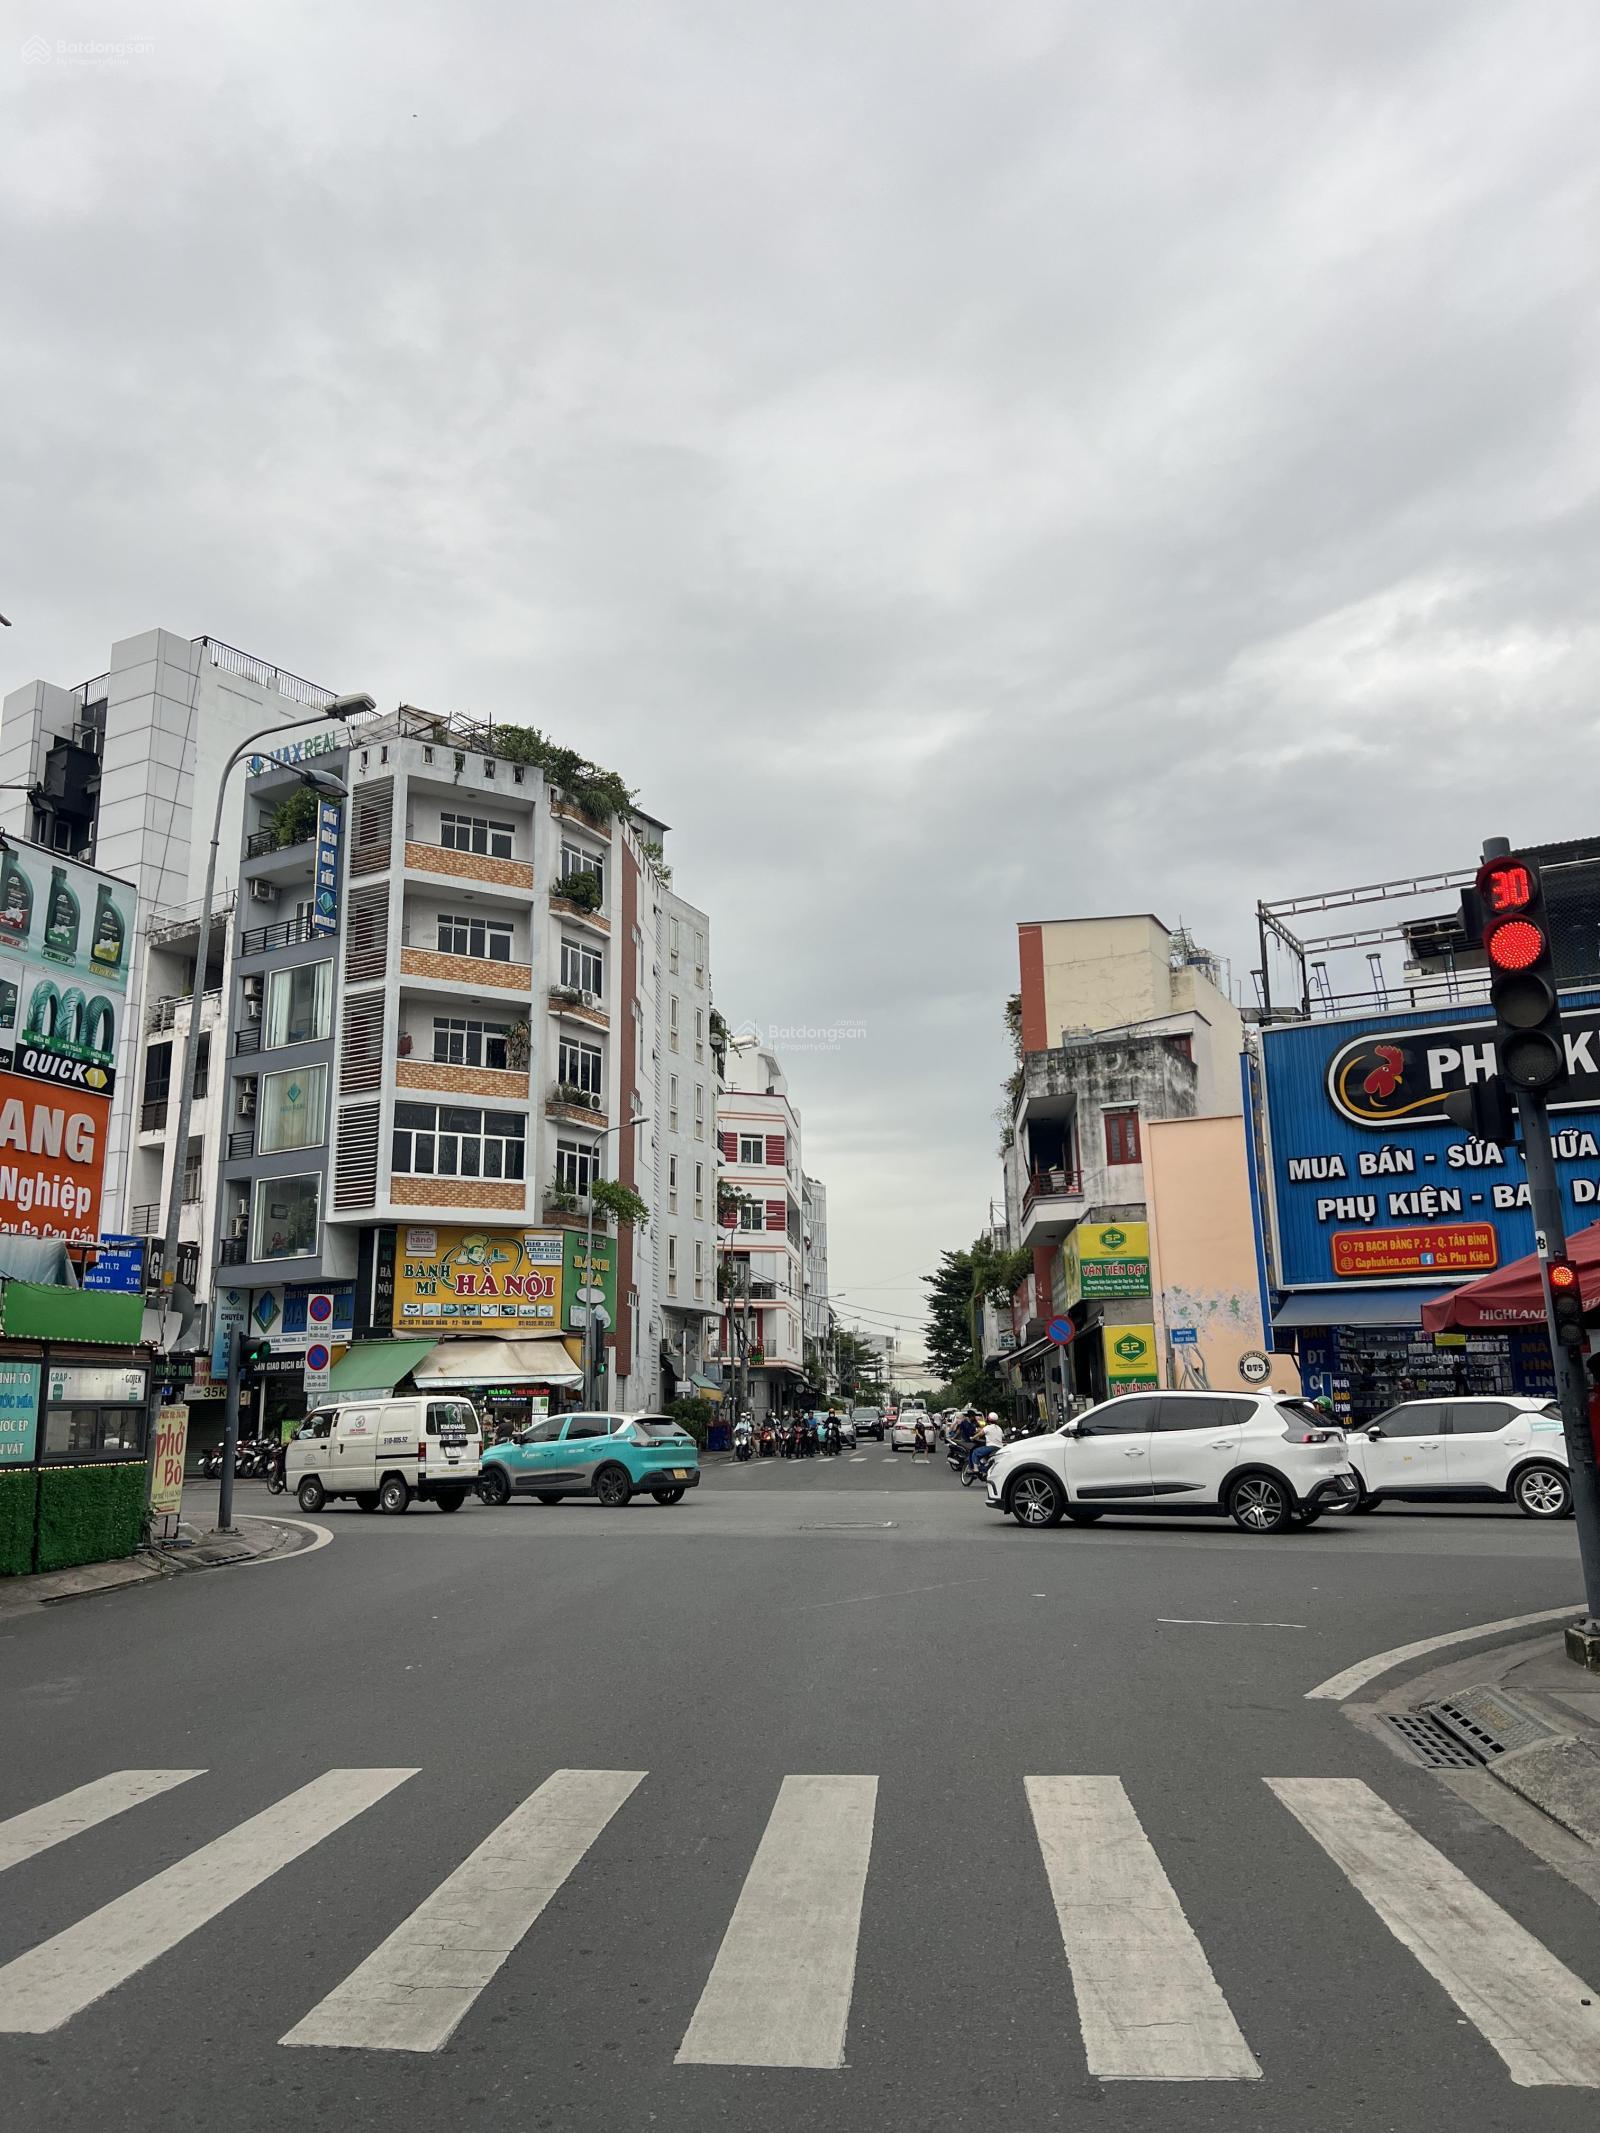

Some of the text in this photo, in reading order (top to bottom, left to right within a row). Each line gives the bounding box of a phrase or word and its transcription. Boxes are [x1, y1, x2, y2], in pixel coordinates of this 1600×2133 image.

[1491, 867, 1530, 910] 30
[22, 1049, 88, 1083] QUICK
[1427, 1030, 1600, 1090] PH K
[1288, 1155, 1347, 1181] MUA
[1359, 1144, 1415, 1175] BÁN
[1447, 1135, 1504, 1168] SỬA
[0, 1165, 92, 1219] Nghiệp
[1317, 1179, 1600, 1222] PHỤ KIỆN BA D
[1353, 1242, 1364, 1252] 79
[1366, 1240, 1388, 1254] BẠCH
[1424, 1238, 1432, 1248] 2
[1438, 1236, 1448, 1249] Q.
[1449, 1232, 1466, 1247] TÂN
[1468, 1232, 1489, 1246] BÌNH
[404, 1260, 452, 1278] BÁNH
[1103, 1261, 1126, 1276] TIẾN
[1127, 1264, 1148, 1278] ĐẠT
[1355, 1250, 1490, 1270] Gaphukien.com Gà Phụ Kiện
[416, 1279, 437, 1296] MÌ
[454, 1264, 557, 1303] HÀ NỘI
[1480, 1307, 1549, 1321] HIGHLAND
[1120, 1342, 1139, 1351] SP
[203, 1385, 226, 1398] 35k
[1524, 1375, 1555, 1388] LIN
[164, 1459, 183, 1489] Bò
